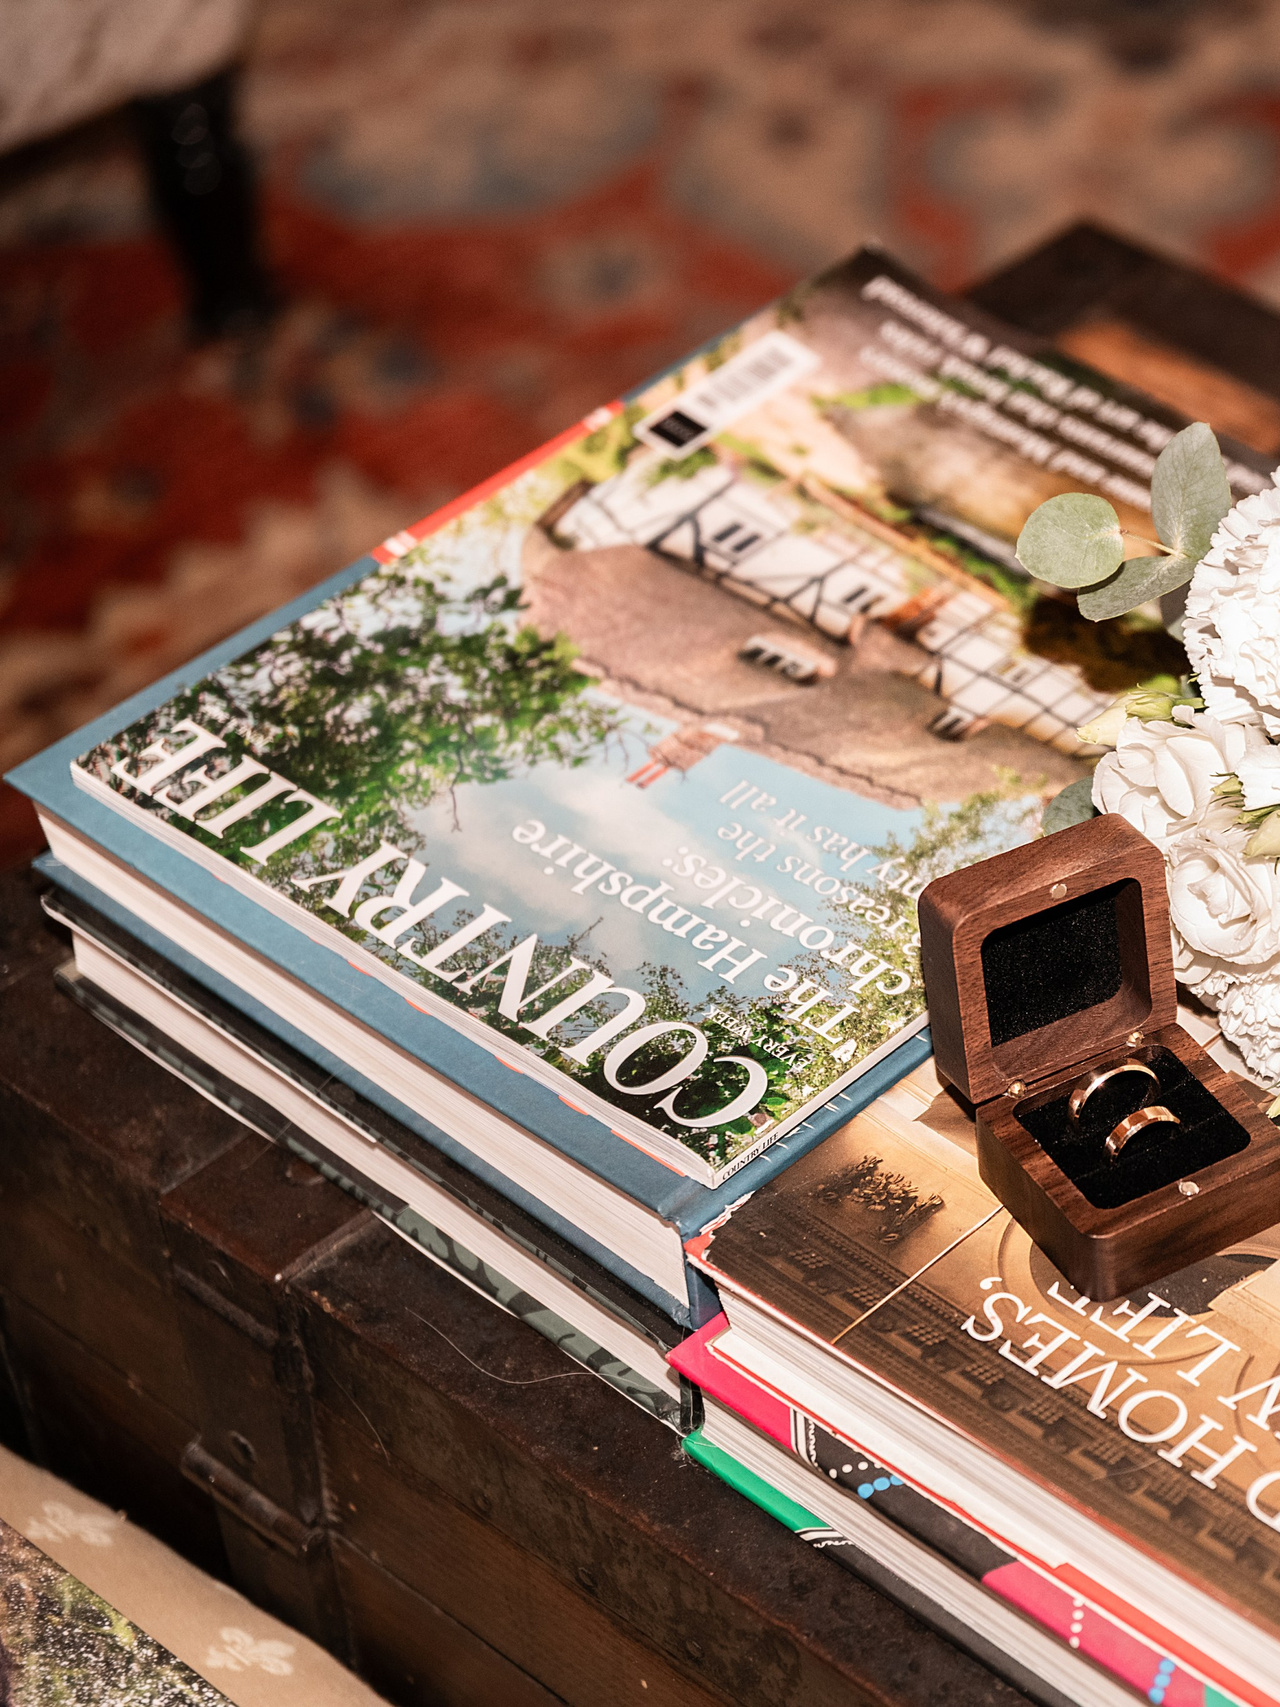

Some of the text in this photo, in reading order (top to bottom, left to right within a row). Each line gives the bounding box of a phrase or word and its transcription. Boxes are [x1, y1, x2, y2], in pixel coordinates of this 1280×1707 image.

[719, 780, 776, 812] all
[774, 807, 807, 835] it
[717, 821, 777, 865] the
[809, 826, 872, 873] has
[111, 717, 768, 1128] COUNTRY LIFE
[662, 846, 911, 996] chronicles:
[776, 860, 909, 934] reasons
[512, 819, 861, 1045] The Hampshire
[702, 1004, 812, 1072] EVERY WEEK
[722, 1131, 779, 1180] COUNTRY LIFE
[961, 1277, 1257, 1489] HOMES,
